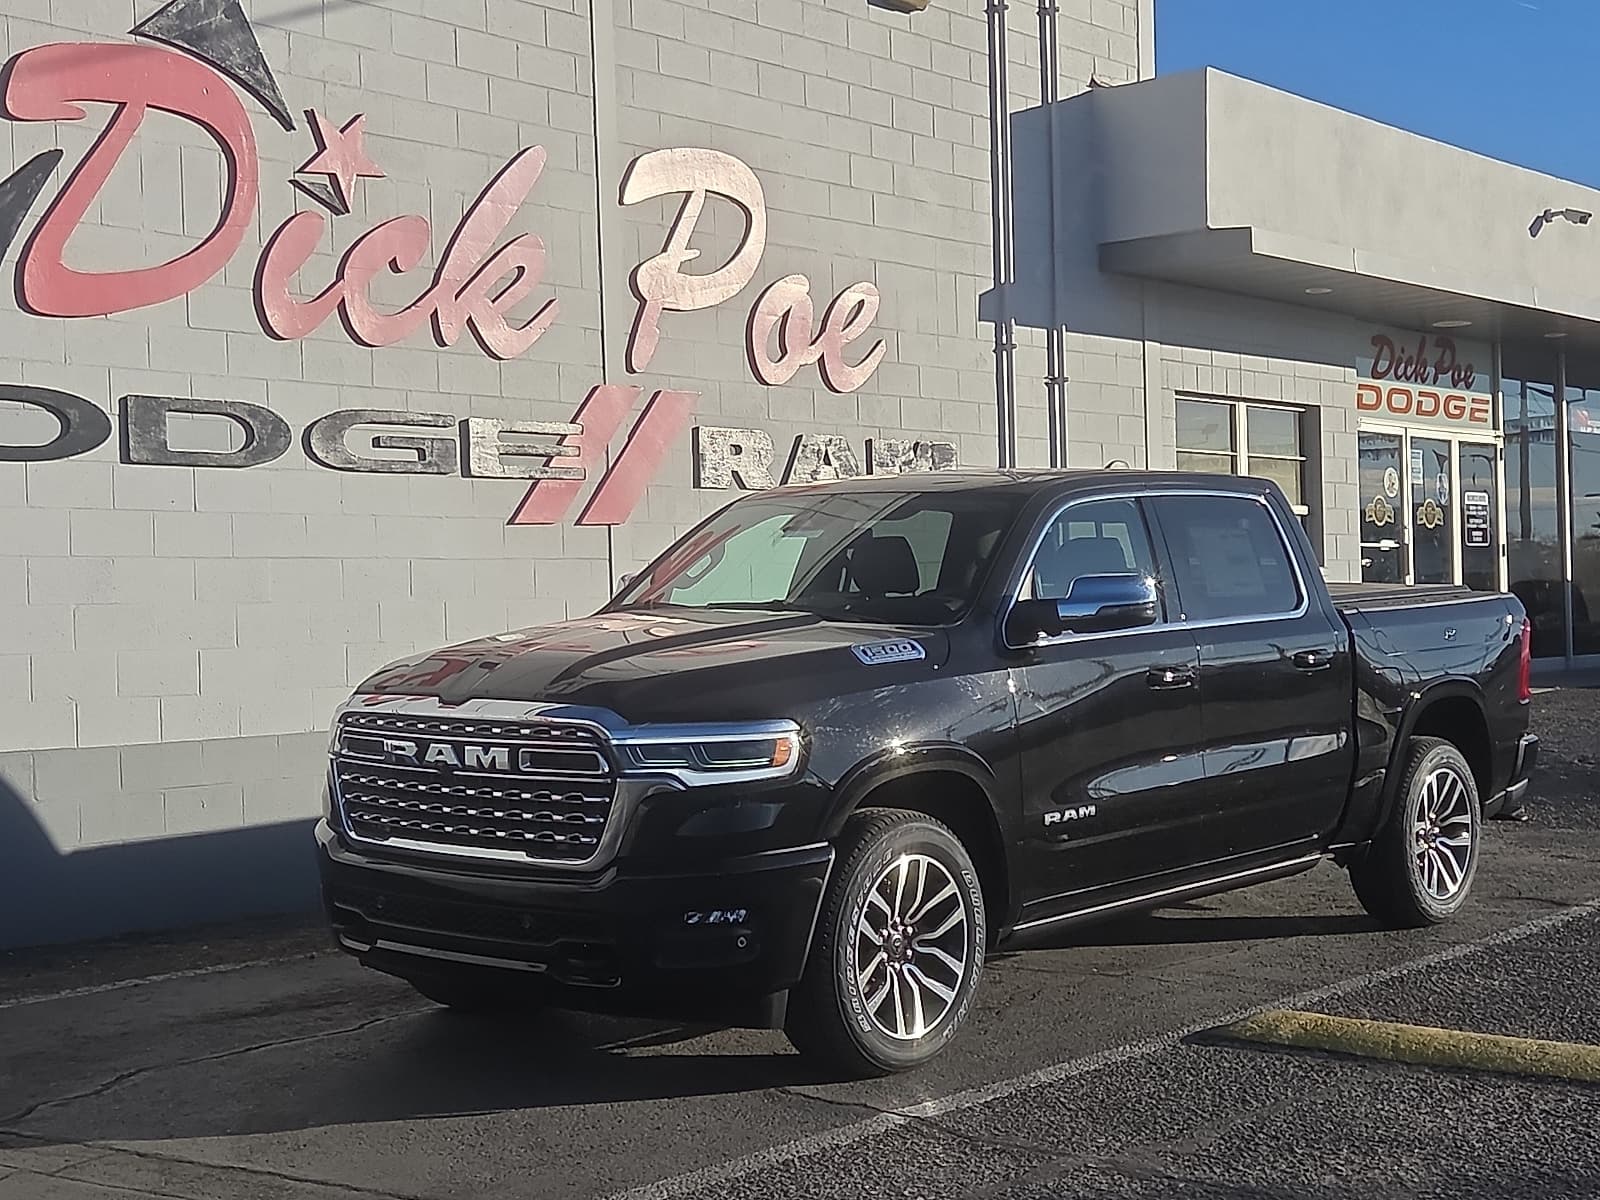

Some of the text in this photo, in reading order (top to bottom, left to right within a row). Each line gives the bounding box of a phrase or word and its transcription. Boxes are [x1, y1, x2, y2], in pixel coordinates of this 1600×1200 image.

[2, 42, 888, 393] Dick Poe
[1371, 334, 1476, 390] Dick Poe
[1356, 383, 1491, 423] DODGE
[384, 740, 510, 770] RAM
[1044, 805, 1096, 825] RAM
